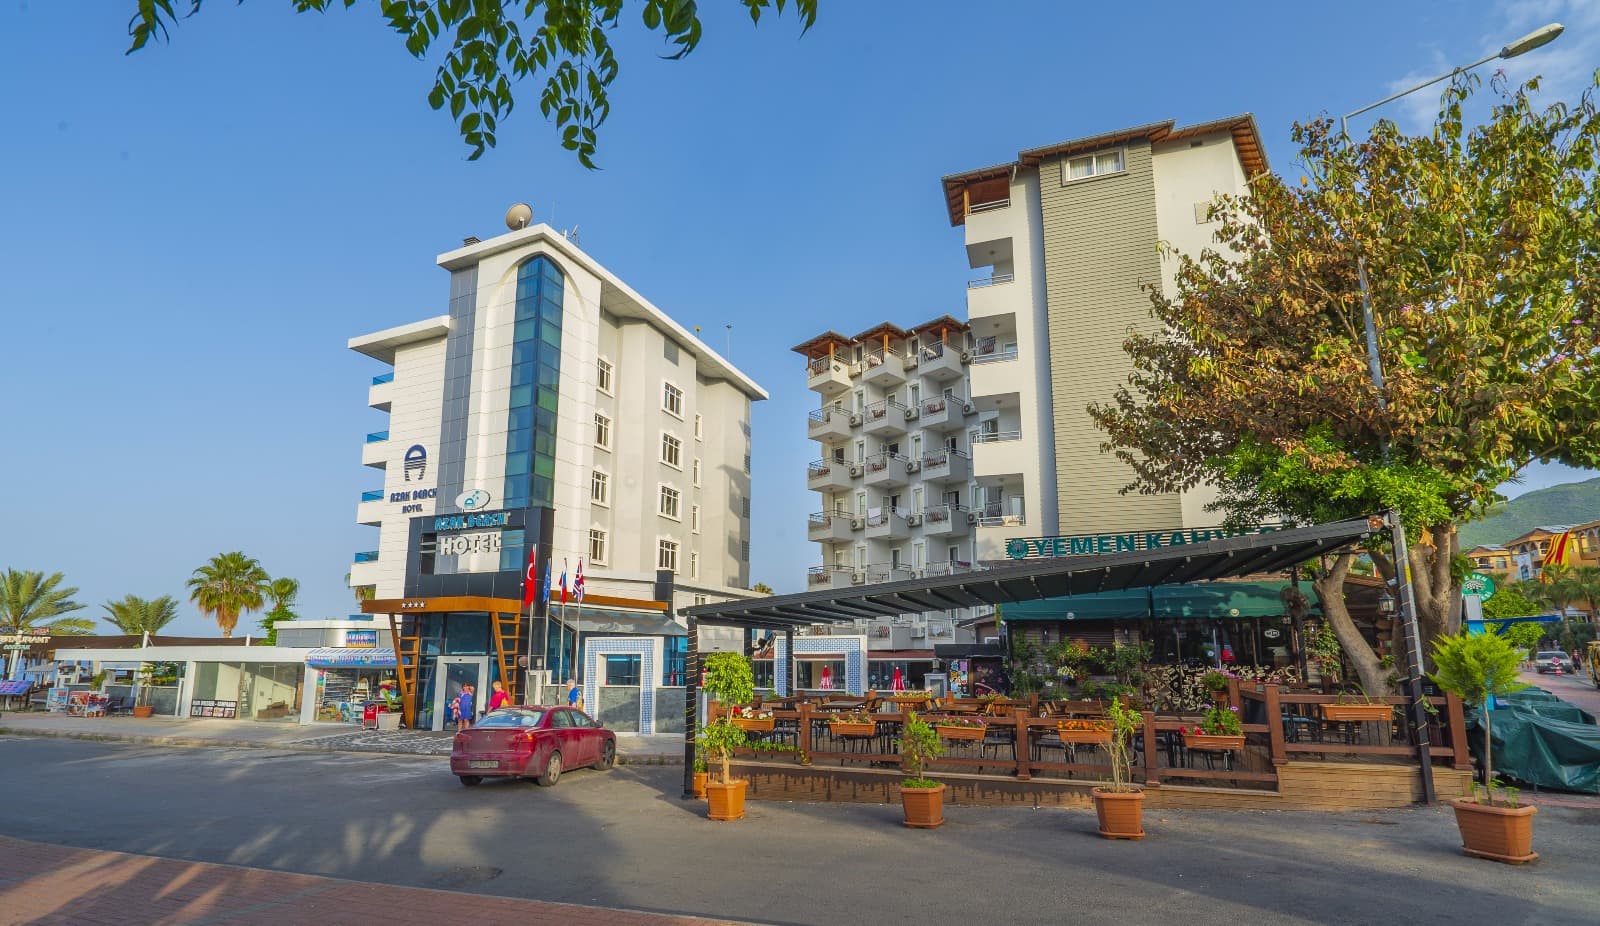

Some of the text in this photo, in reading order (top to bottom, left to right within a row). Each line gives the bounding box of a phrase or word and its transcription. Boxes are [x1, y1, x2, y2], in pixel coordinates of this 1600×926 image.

[390, 487, 437, 503] AZAK BEACH
[402, 503, 423, 514] HOTEL
[434, 512, 505, 531] AZAK BEACH
[440, 533, 502, 556] HOTEL
[1032, 534, 1135, 556] YEMEN
